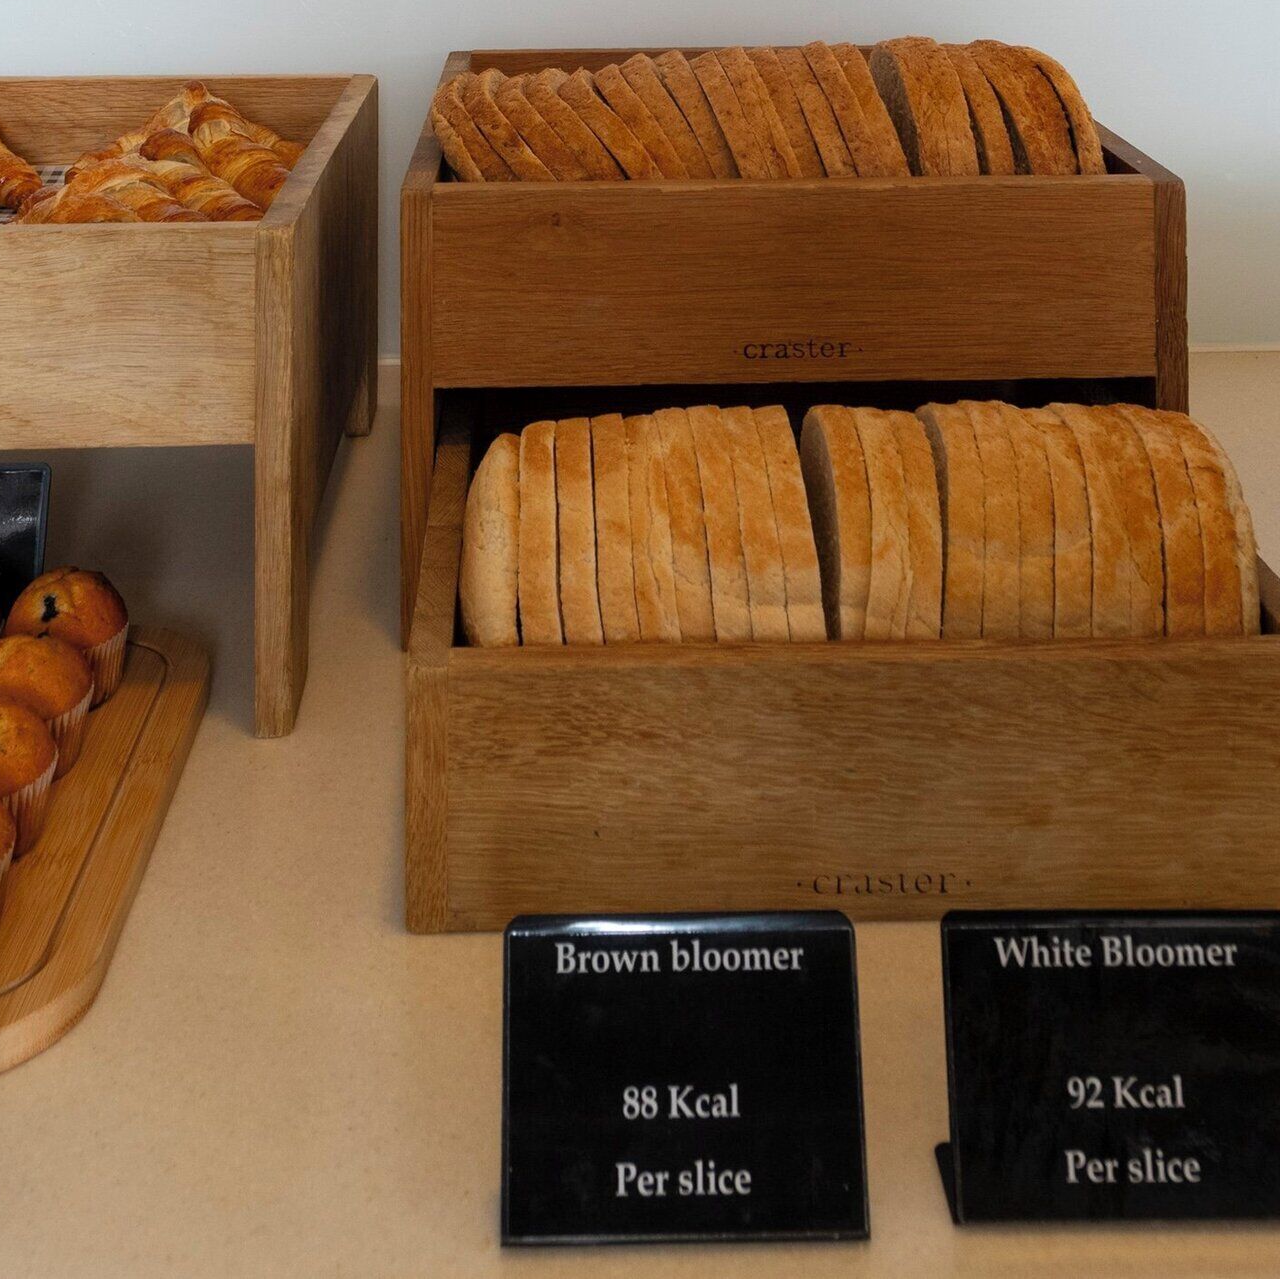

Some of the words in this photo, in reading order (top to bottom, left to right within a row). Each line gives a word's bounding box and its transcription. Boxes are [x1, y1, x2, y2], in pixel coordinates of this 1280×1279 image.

[743, 338, 852, 360] craster
[813, 872, 956, 895] craster
[555, 942, 660, 974] Brown
[670, 939, 804, 973] bloomer
[994, 936, 1092, 968] White
[1101, 934, 1238, 967] Bloomer
[622, 1086, 659, 1120] 88
[668, 1083, 740, 1119] Kcal
[1067, 1076, 1105, 1109] 92
[1112, 1075, 1185, 1108] Kcal
[615, 1162, 669, 1197] Per
[678, 1159, 752, 1196] slice
[1065, 1150, 1119, 1183] Per
[1127, 1148, 1201, 1183] slice
